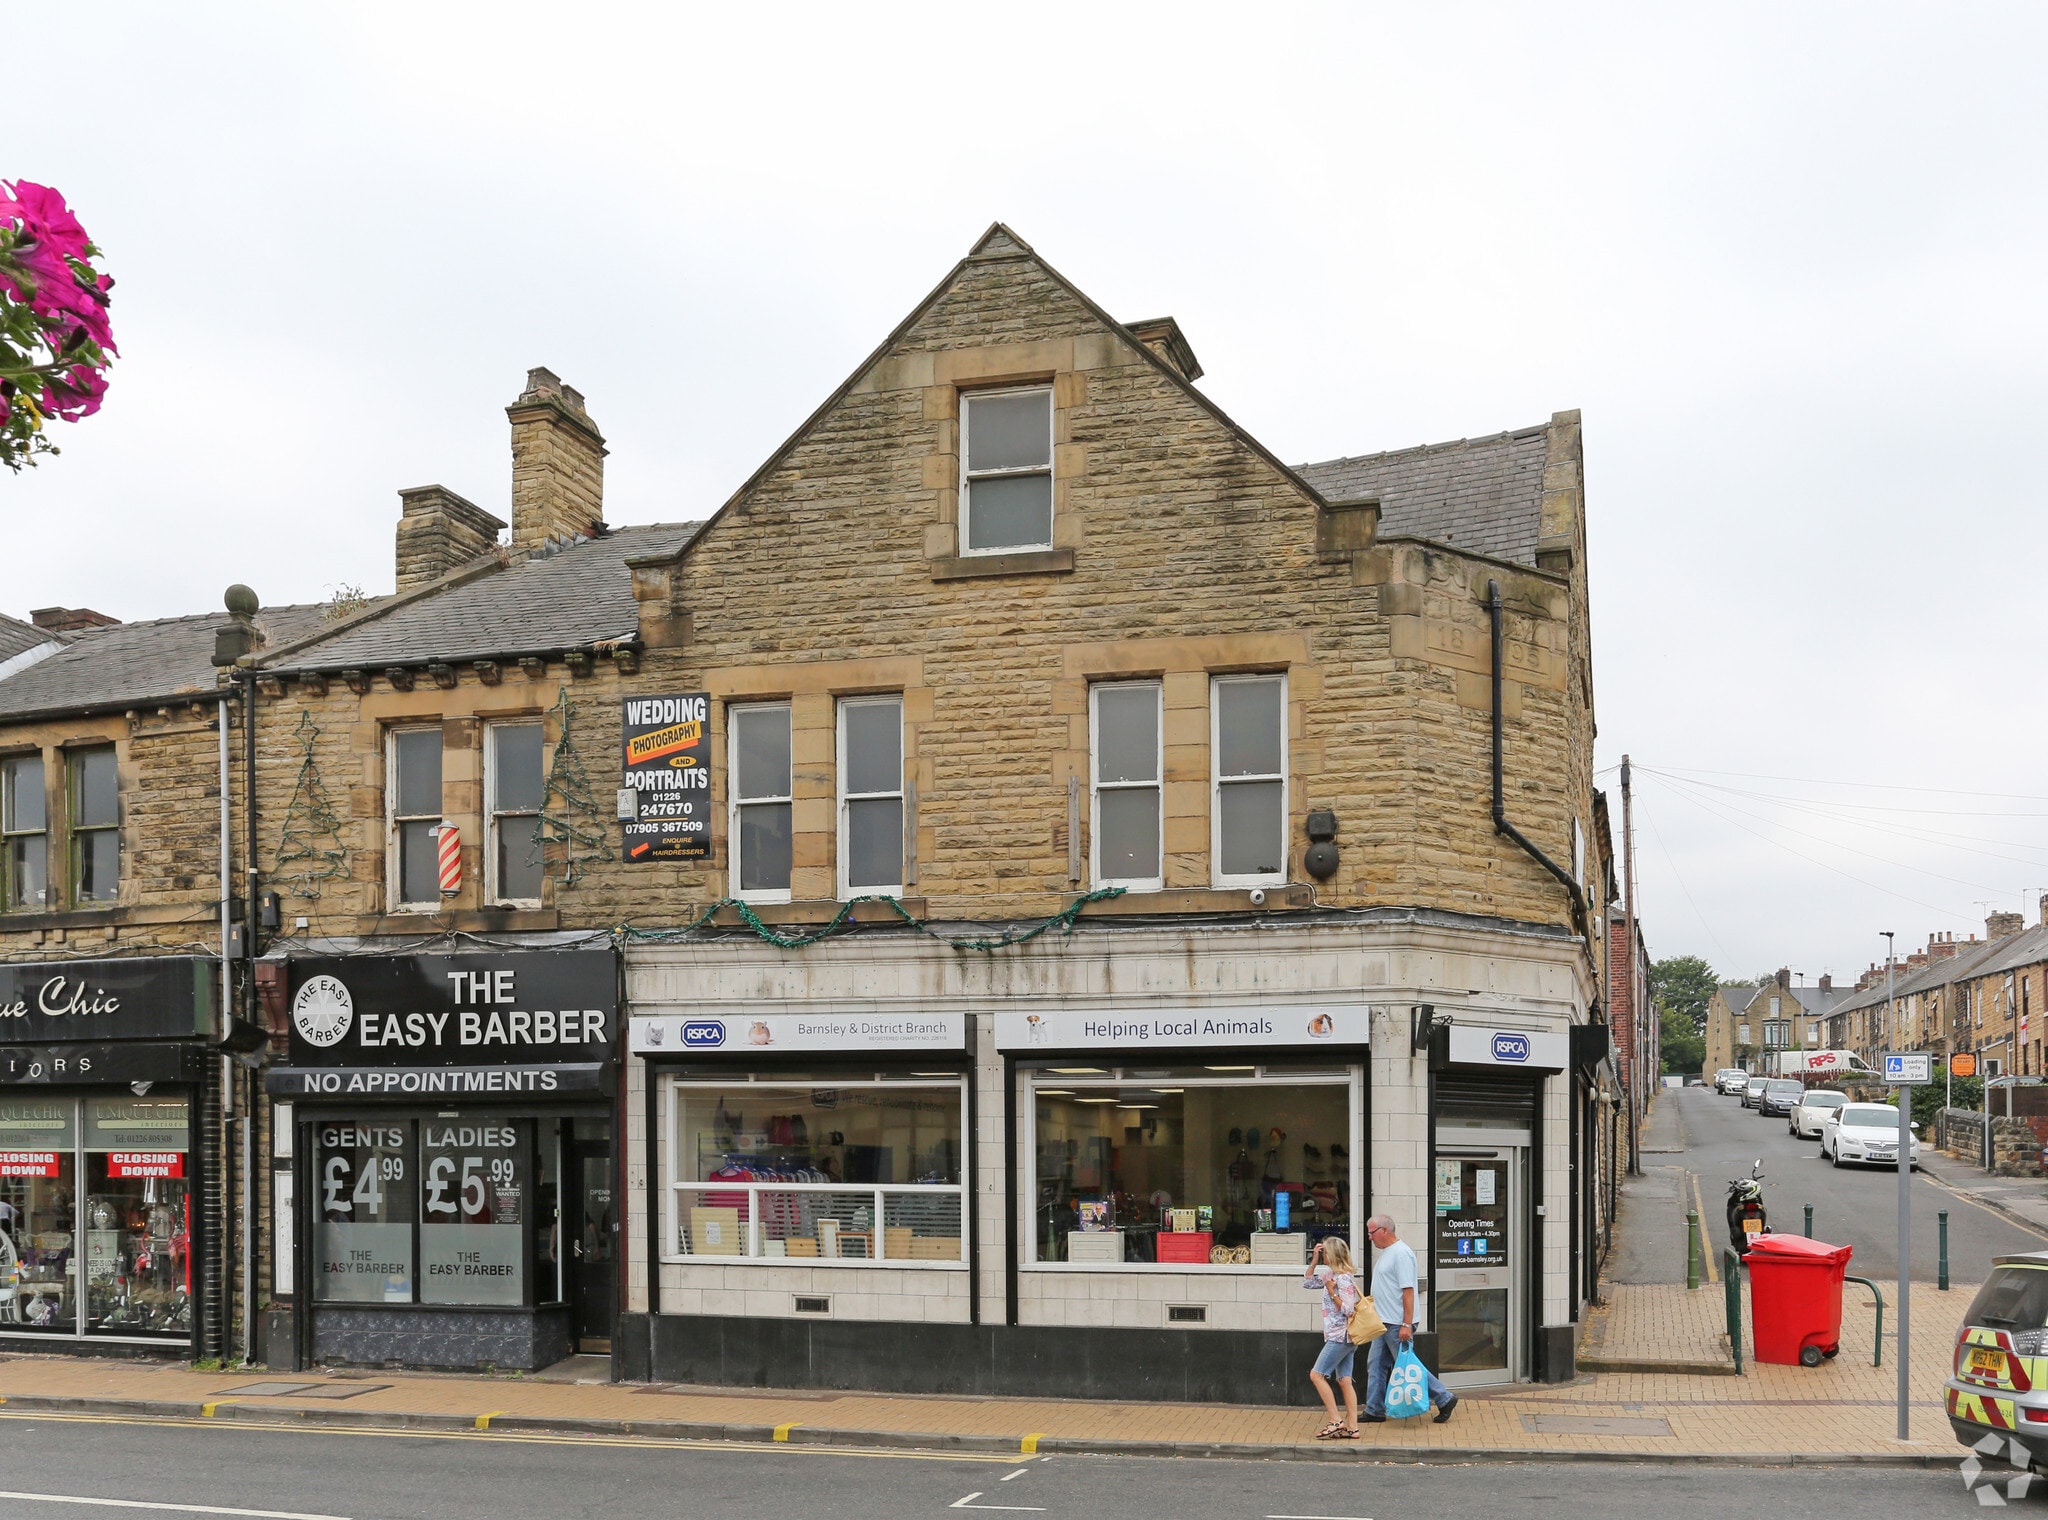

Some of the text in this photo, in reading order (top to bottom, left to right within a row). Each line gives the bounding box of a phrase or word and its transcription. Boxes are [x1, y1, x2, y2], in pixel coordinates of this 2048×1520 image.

[627, 697, 706, 726] WEDDING
[633, 723, 696, 755] PHOTOGRAPHY
[625, 767, 708, 791] PORTRAITS
[652, 792, 681, 801] 01226
[640, 802, 693, 817] 247670
[625, 821, 703, 834] 07905 367509
[652, 848, 705, 856] HAIRDRESSERS
[447, 970, 516, 1004] THE
[39, 975, 120, 1016] Chic
[297, 980, 349, 1011] THE EASY
[299, 1016, 348, 1042] BARBER
[360, 1010, 607, 1047] EASY BARBER
[687, 1027, 720, 1040] RSPCA
[798, 1021, 947, 1037] Barnsley & District Branch
[1085, 1017, 1273, 1040] Helping Local Animals
[1496, 1040, 1526, 1054] RSPCA
[1808, 1052, 1836, 1068] RPS
[1904, 1059, 1926, 1067] Loading
[304, 1073, 341, 1092] NO
[347, 1070, 558, 1092] APPOINTMENTS
[33, 1106, 66, 1119] CHIC
[96, 1105, 153, 1120] UNIQUE
[114, 1135, 173, 1143] Tel: 01226 805308
[322, 1128, 404, 1147] GENTS
[426, 1127, 517, 1147] LADIES
[0, 1153, 54, 1163] LOSING
[112, 1153, 178, 1164] CLOSING
[1, 1165, 46, 1175] DOWN
[121, 1166, 169, 1176] DOWN
[1448, 1219, 1494, 1229] Opening Times
[350, 1251, 372, 1261] THE
[457, 1252, 480, 1263] THE
[323, 1262, 405, 1274] EASY BARBER
[430, 1264, 514, 1276] EASY BARBER
